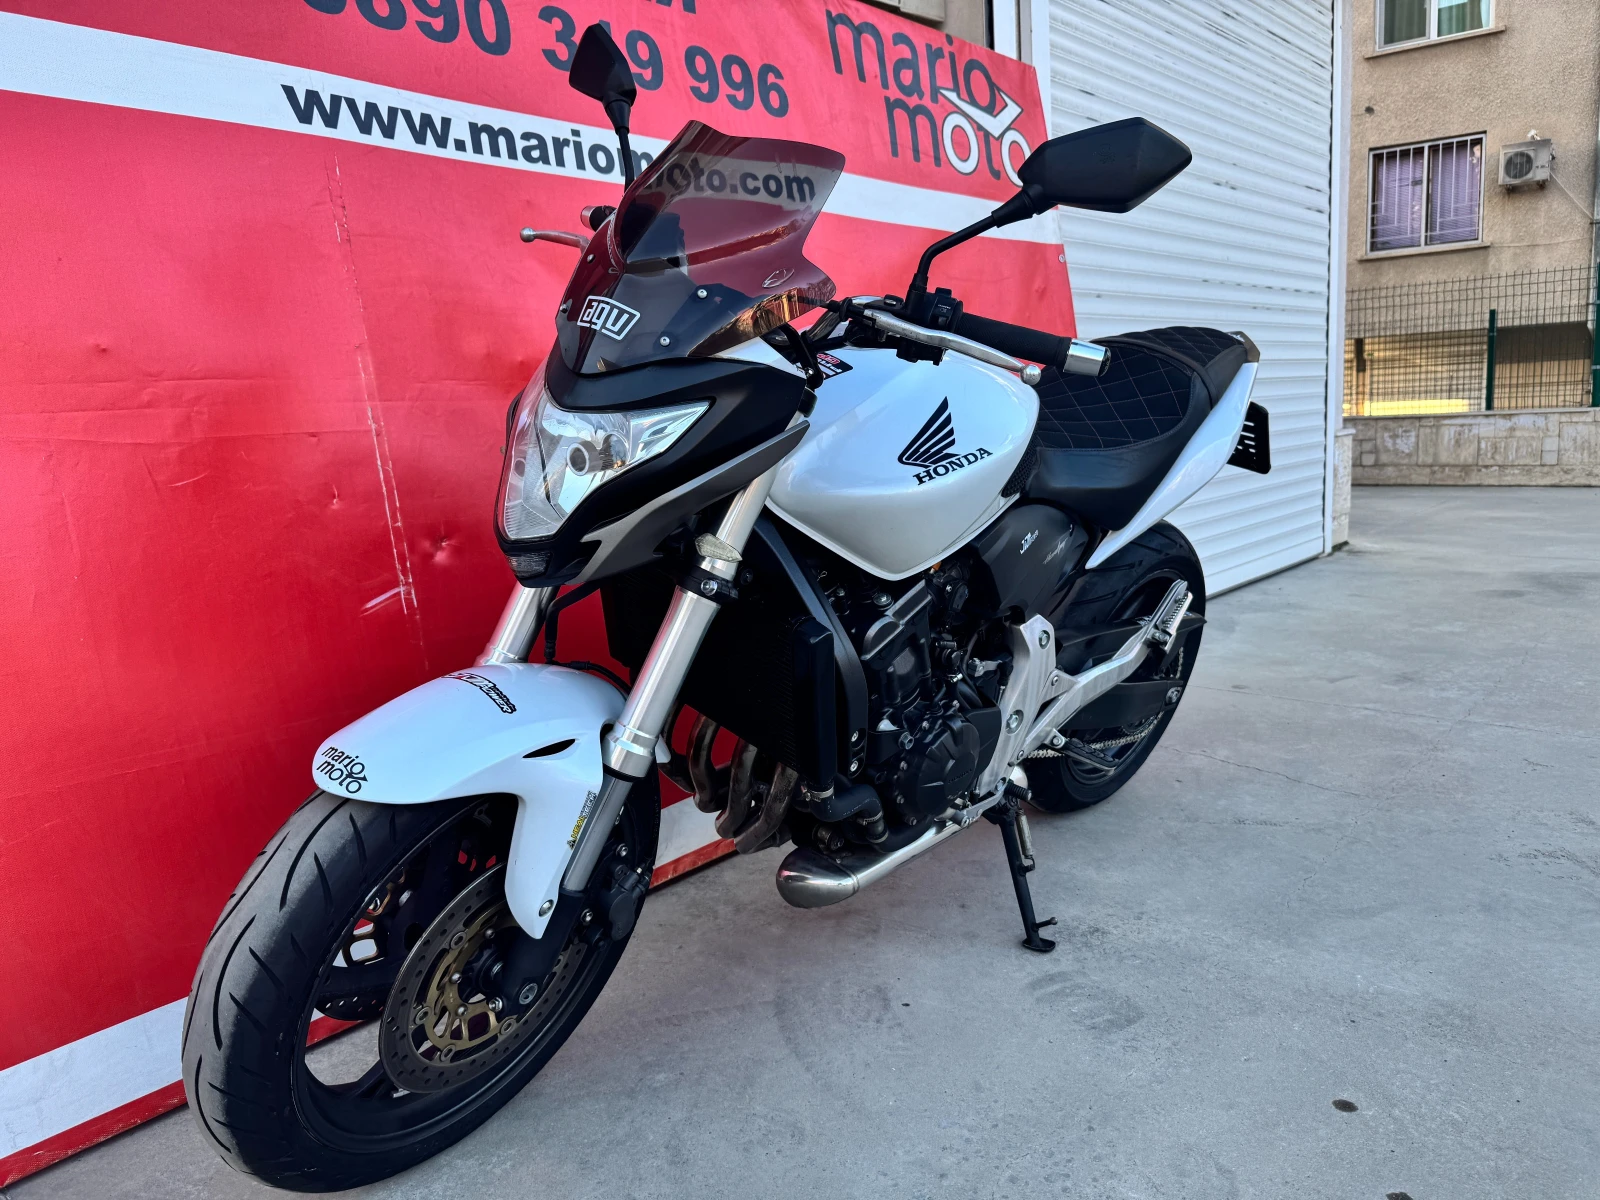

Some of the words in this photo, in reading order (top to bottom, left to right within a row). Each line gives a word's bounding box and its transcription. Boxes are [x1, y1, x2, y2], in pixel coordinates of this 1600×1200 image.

[537, 5, 664, 91] 39
[684, 45, 789, 118] 996
[825, 9, 998, 113] mario
[912, 447, 994, 486] HONDA
[316, 760, 362, 794] moto
[321, 746, 366, 775] mario
